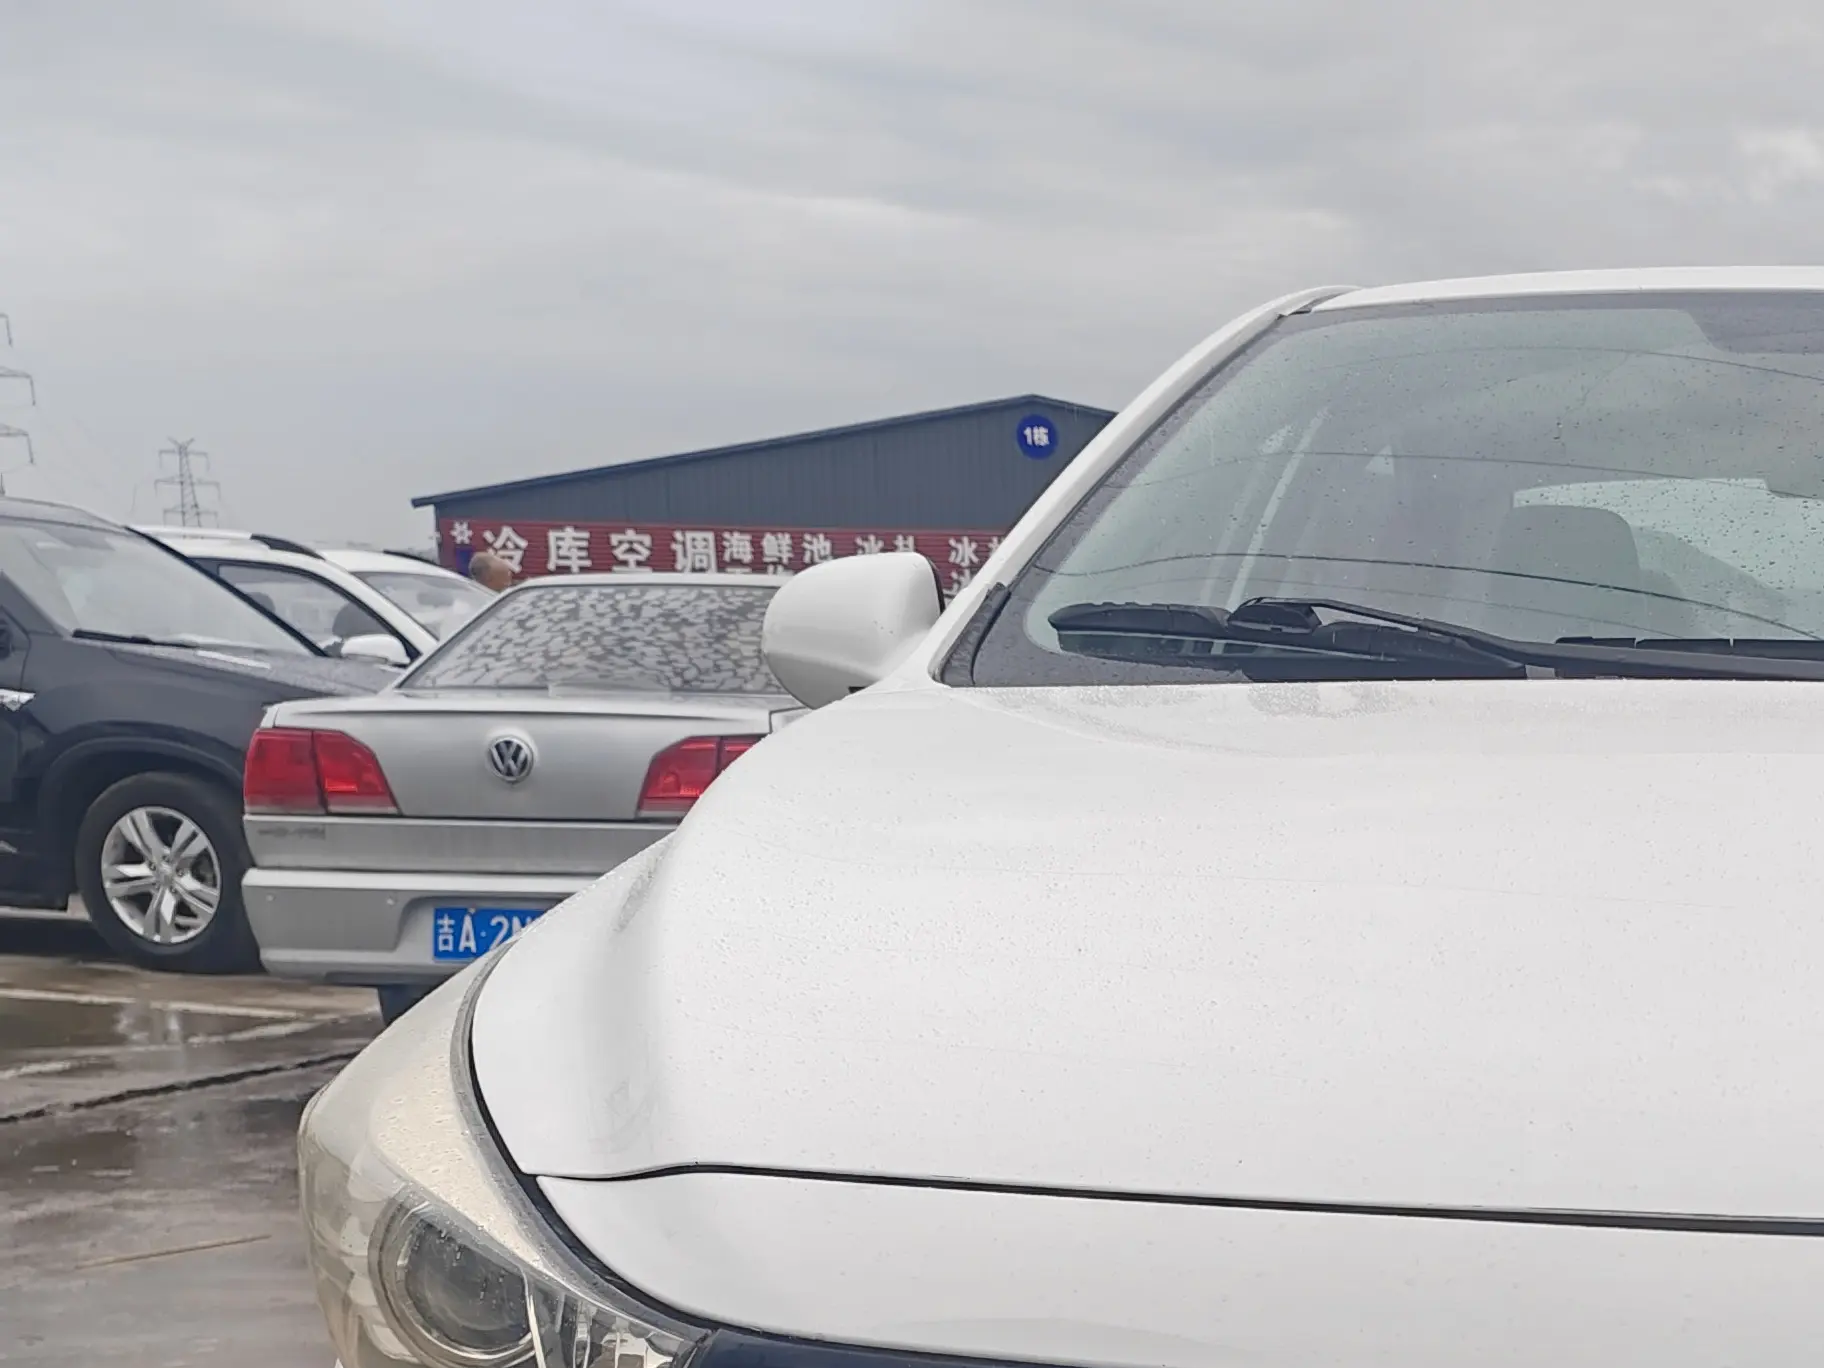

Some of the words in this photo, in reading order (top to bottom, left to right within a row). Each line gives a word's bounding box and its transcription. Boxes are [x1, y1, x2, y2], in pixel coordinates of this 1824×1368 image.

[483, 525, 718, 573] 冷库空调
[722, 531, 832, 564] 海鲜池
